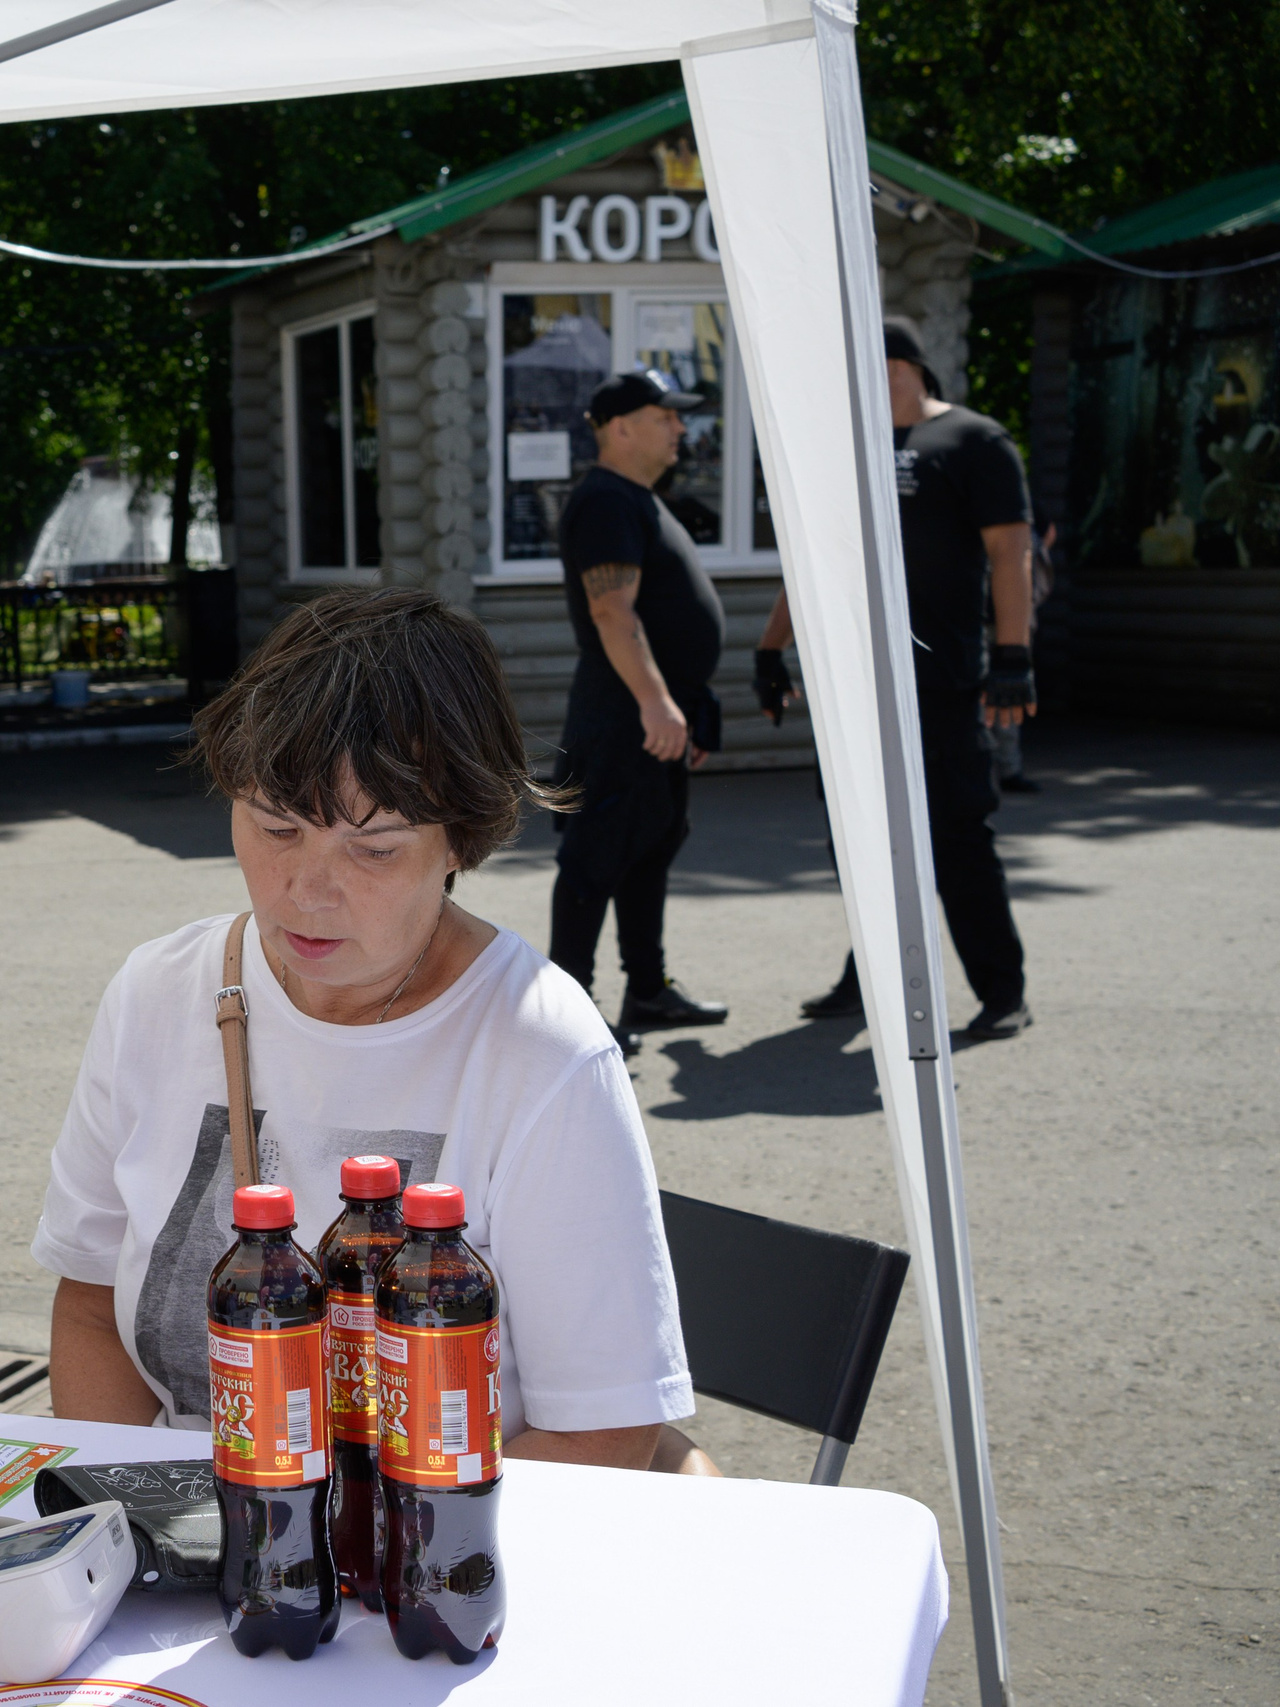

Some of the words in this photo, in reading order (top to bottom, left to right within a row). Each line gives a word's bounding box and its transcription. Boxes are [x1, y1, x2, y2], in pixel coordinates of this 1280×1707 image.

[352, 1316, 375, 1324] ПРОВЕ
[219, 1347, 249, 1359] ПРОВЕРЕНО
[331, 1339, 376, 1355] ВЯТСК
[379, 1341, 404, 1354] ПРОВЕРЕНО
[210, 1371, 253, 1392] ЯТСКИЙ
[377, 1367, 408, 1389] ТСКИЙ
[211, 1383, 255, 1421] ВАС
[43, 1689, 103, 1698] ДОПУСКАЙТЕ
